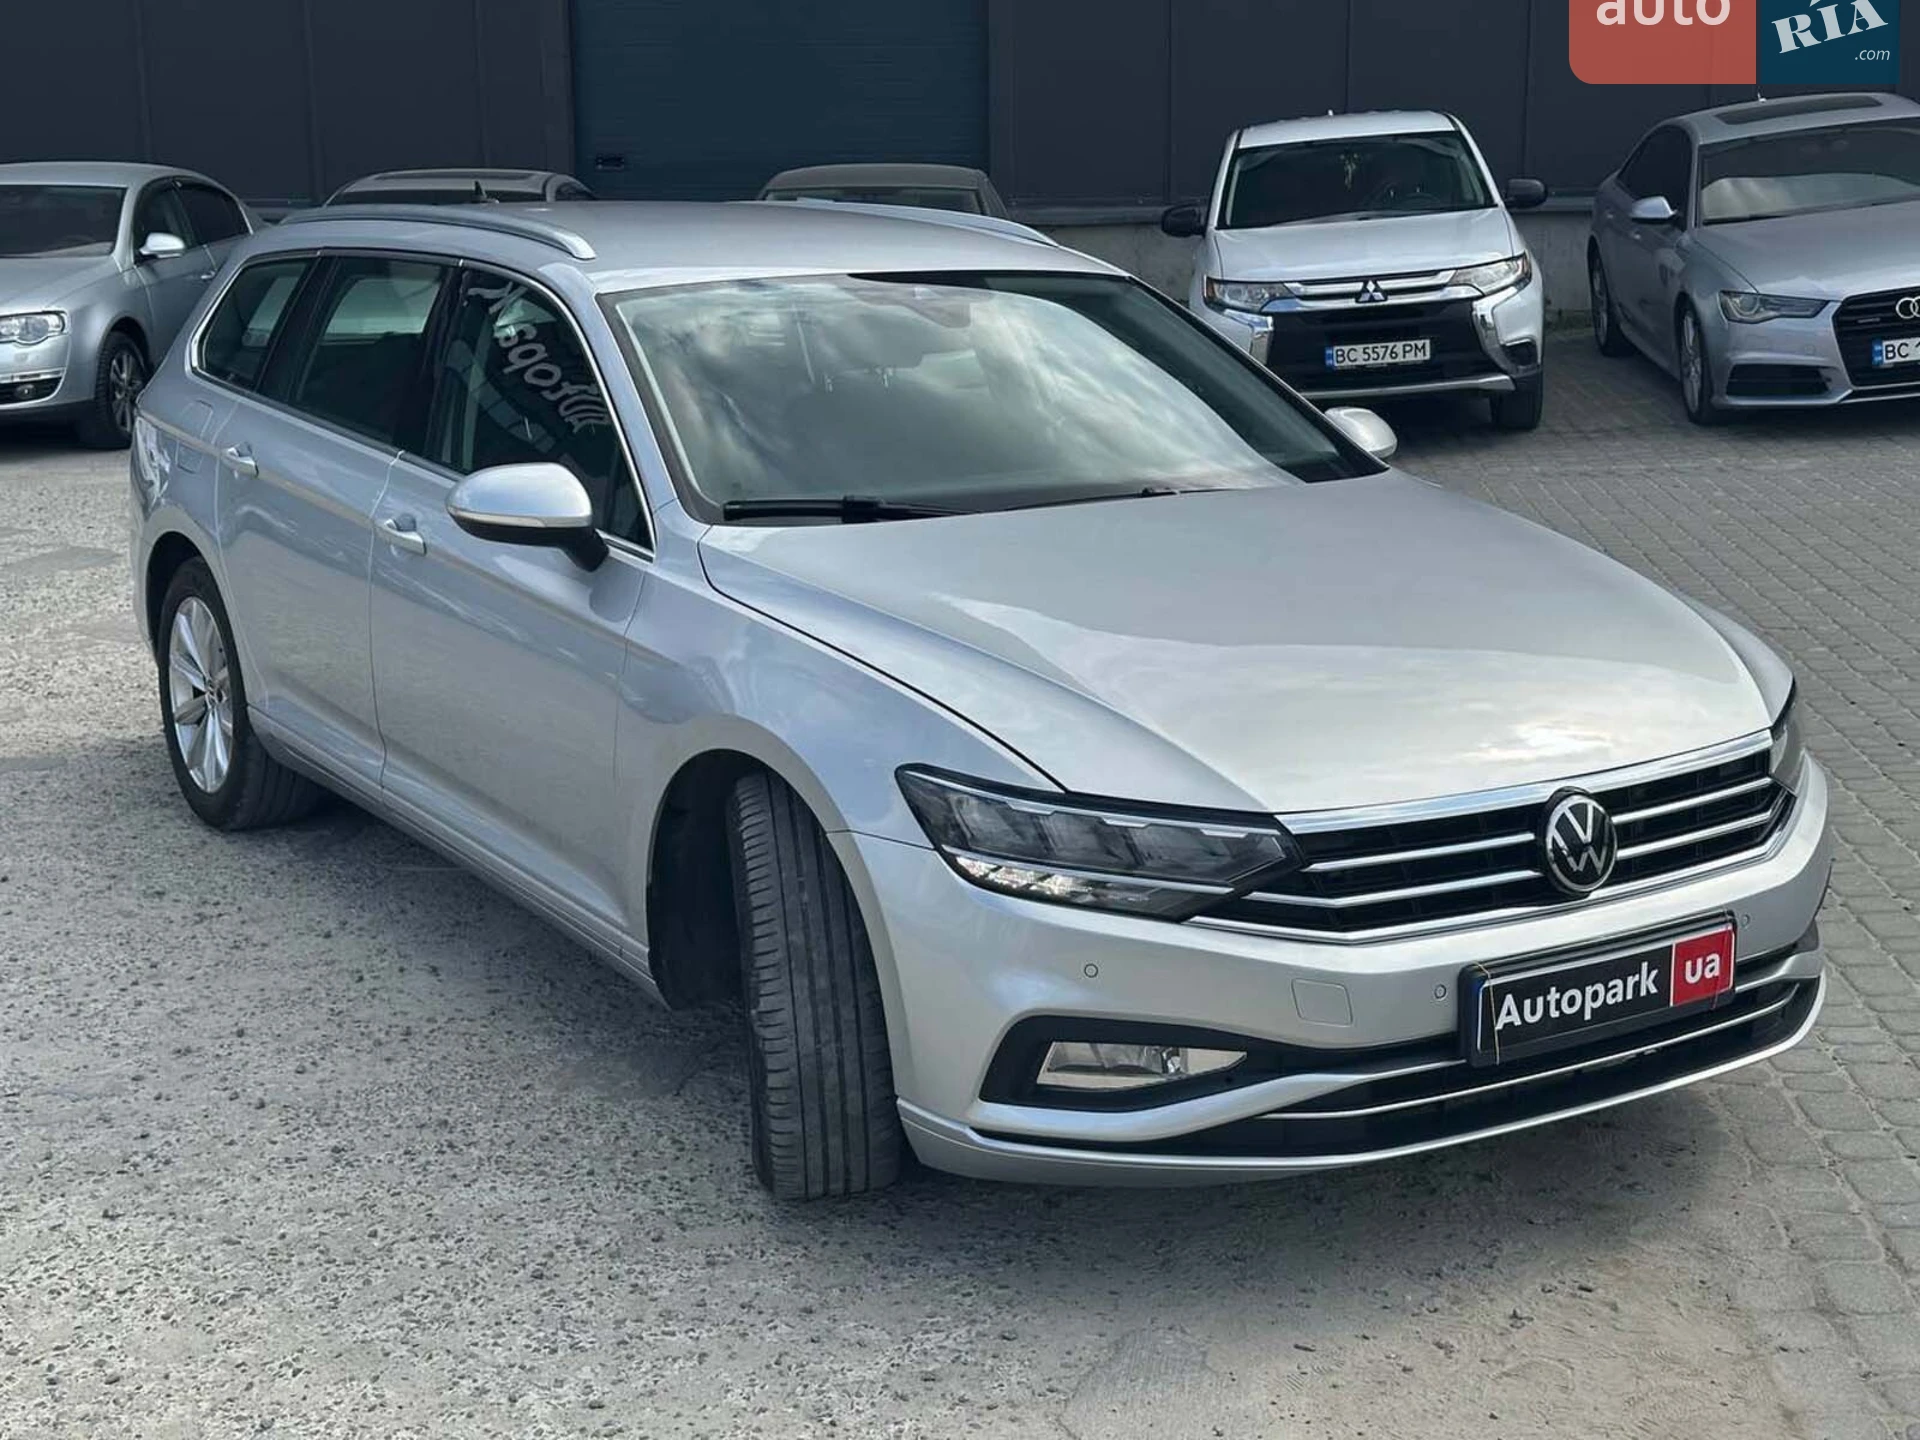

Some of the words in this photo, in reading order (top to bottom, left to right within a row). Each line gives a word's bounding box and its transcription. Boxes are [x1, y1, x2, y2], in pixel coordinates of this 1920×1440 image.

[1335, 348, 1358, 364] BC
[1362, 344, 1399, 362] 5576
[1402, 342, 1427, 359] PM
[1885, 342, 1909, 360] BC
[1493, 961, 1659, 1031] Autopark
[1684, 952, 1720, 985] ua
